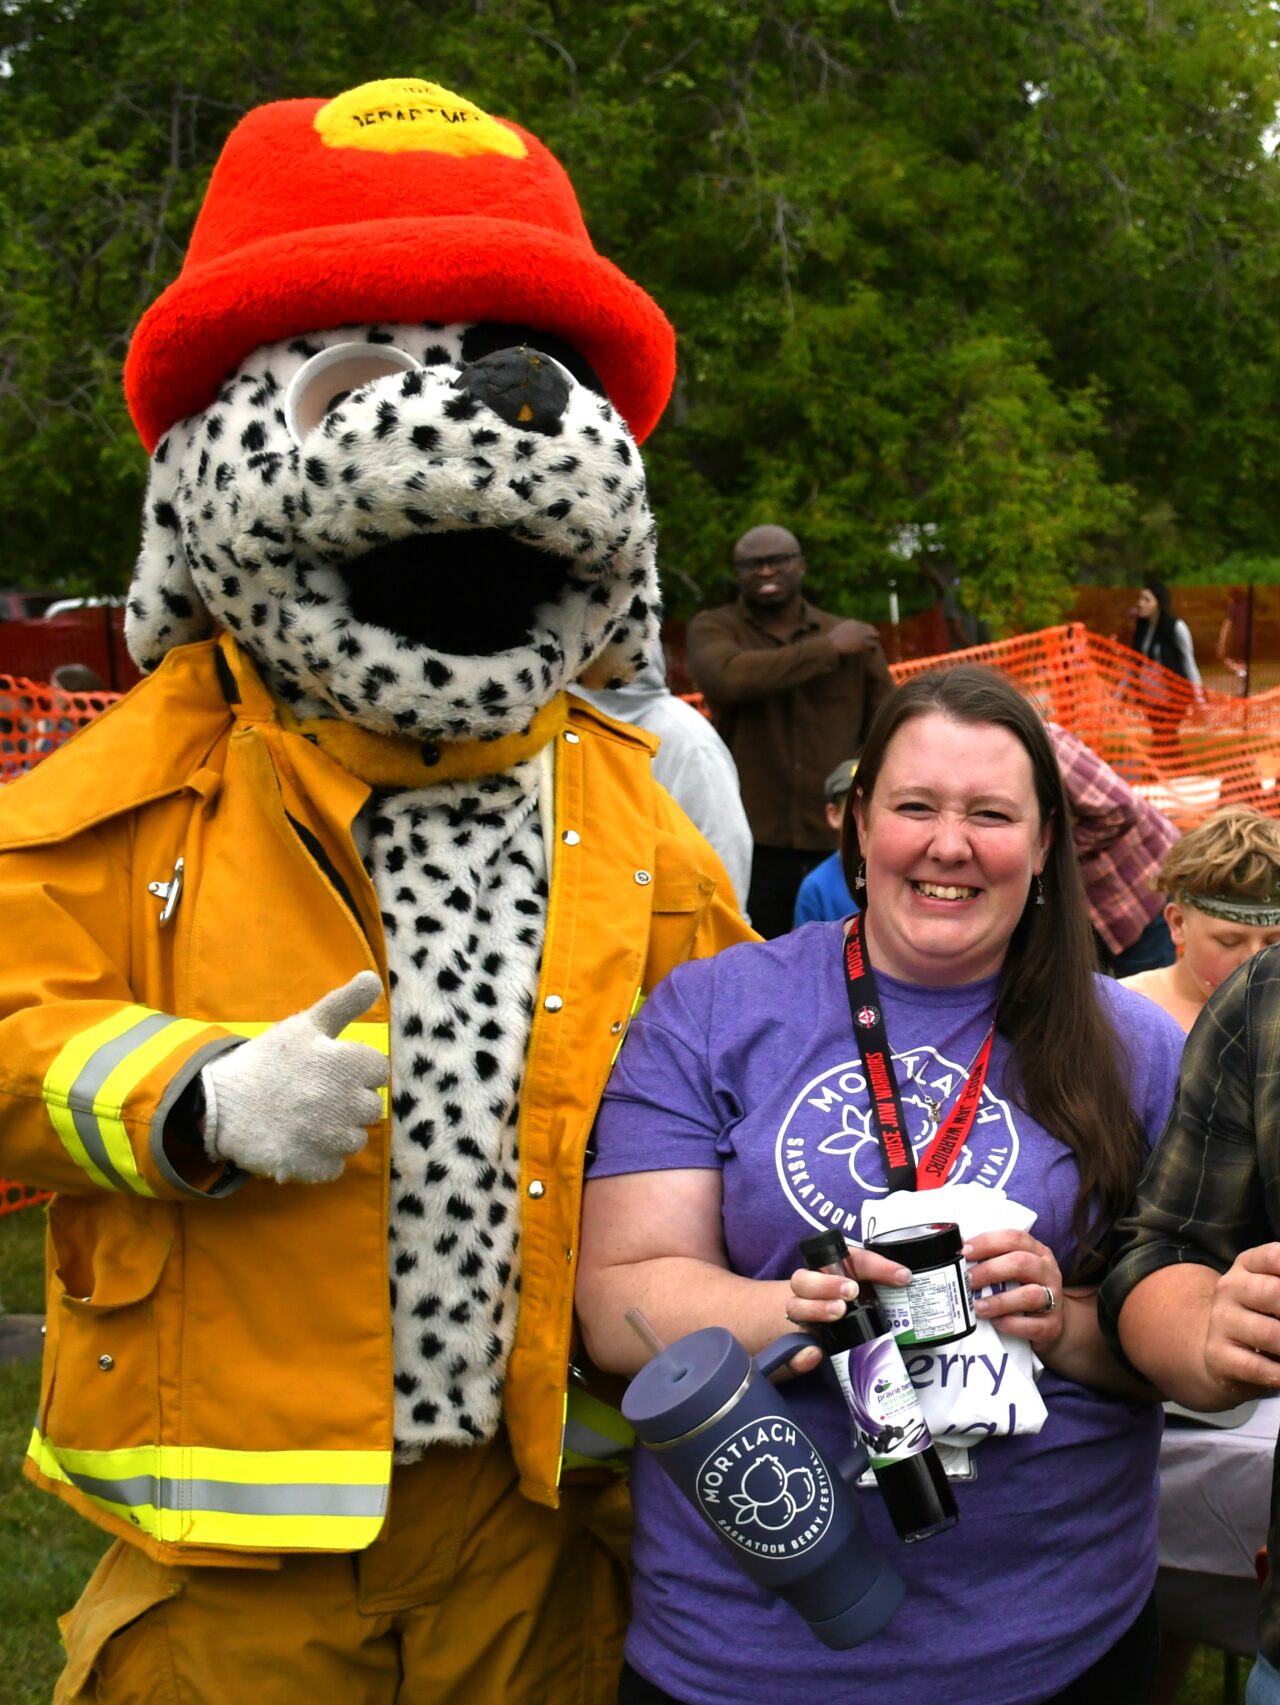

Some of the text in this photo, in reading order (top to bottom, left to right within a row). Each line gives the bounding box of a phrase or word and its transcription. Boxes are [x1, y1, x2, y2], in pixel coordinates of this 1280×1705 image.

[808, 1056, 1001, 1125] MOTLAH
[865, 1052, 893, 1101] WARRIORS
[877, 1102, 898, 1130] JAW
[882, 1131, 907, 1168] MOOSE
[925, 1063, 985, 1178] MOOSE JAW WARRIORS
[787, 1138, 857, 1231] SASKATOON
[905, 1353, 1009, 1396] erry
[703, 1423, 796, 1503] MORTLACH
[718, 1451, 830, 1553] SASKATOON BERRY FESTIVAL
